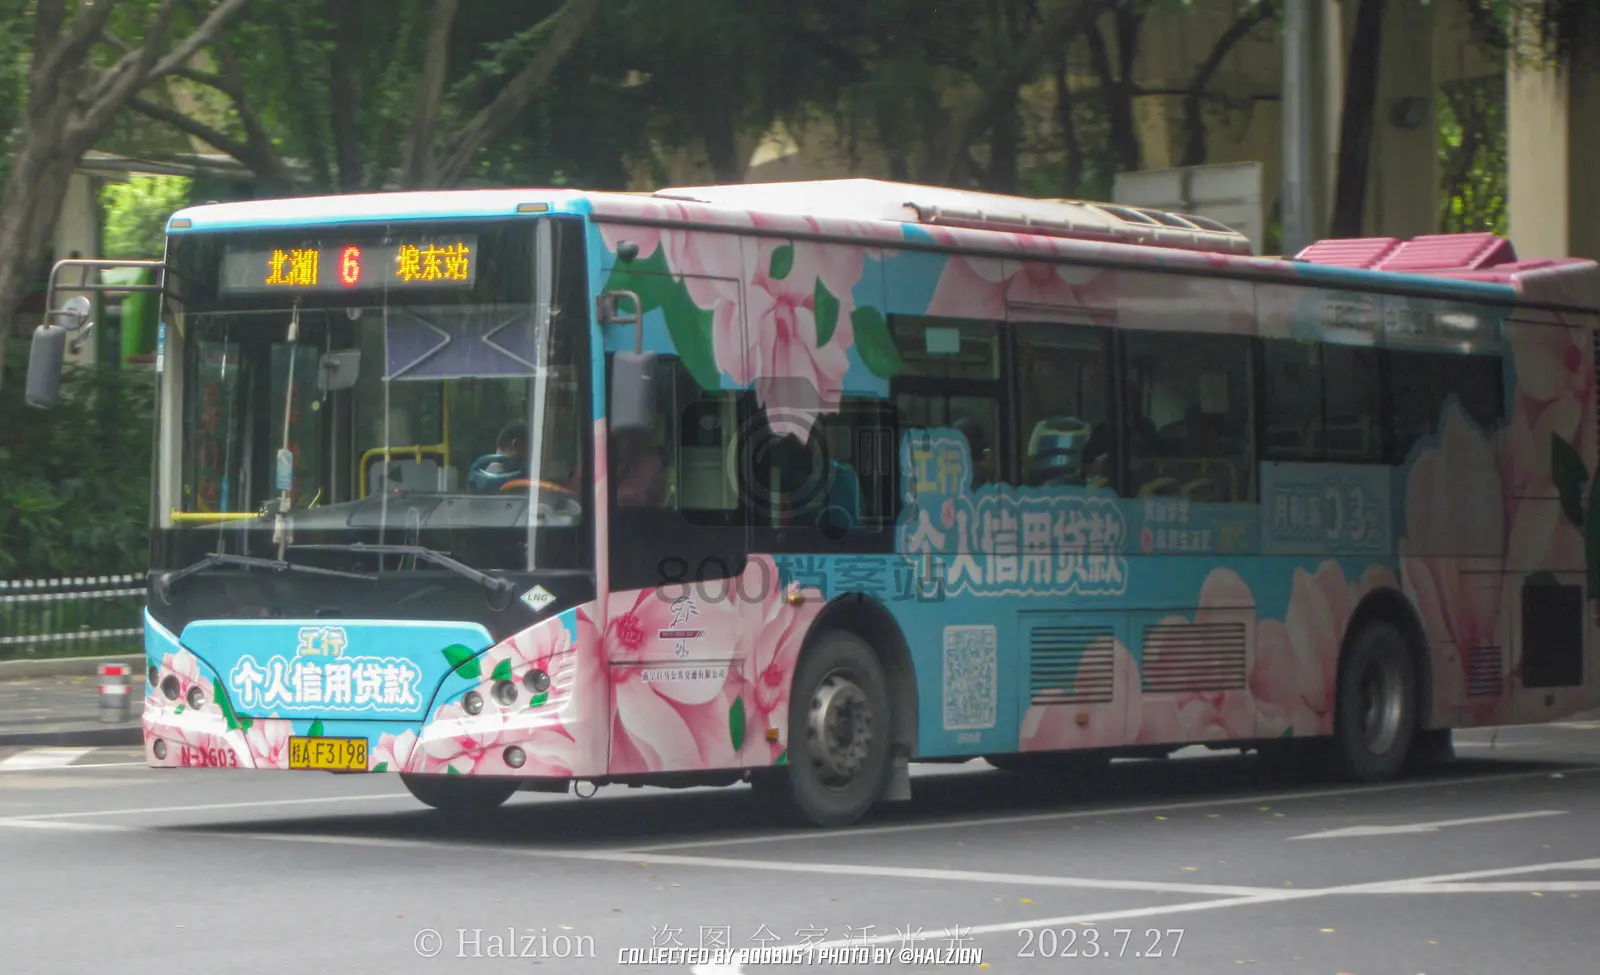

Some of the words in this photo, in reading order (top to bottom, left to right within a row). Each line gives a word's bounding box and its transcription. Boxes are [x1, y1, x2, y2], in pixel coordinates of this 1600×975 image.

[266, 249, 319, 284] 北湖
[341, 246, 360, 285] 6
[908, 507, 1123, 586] 个人信用贷款
[527, 593, 549, 602] LNG
[301, 630, 344, 657] 工行
[234, 661, 416, 706] 个人信用贷款
